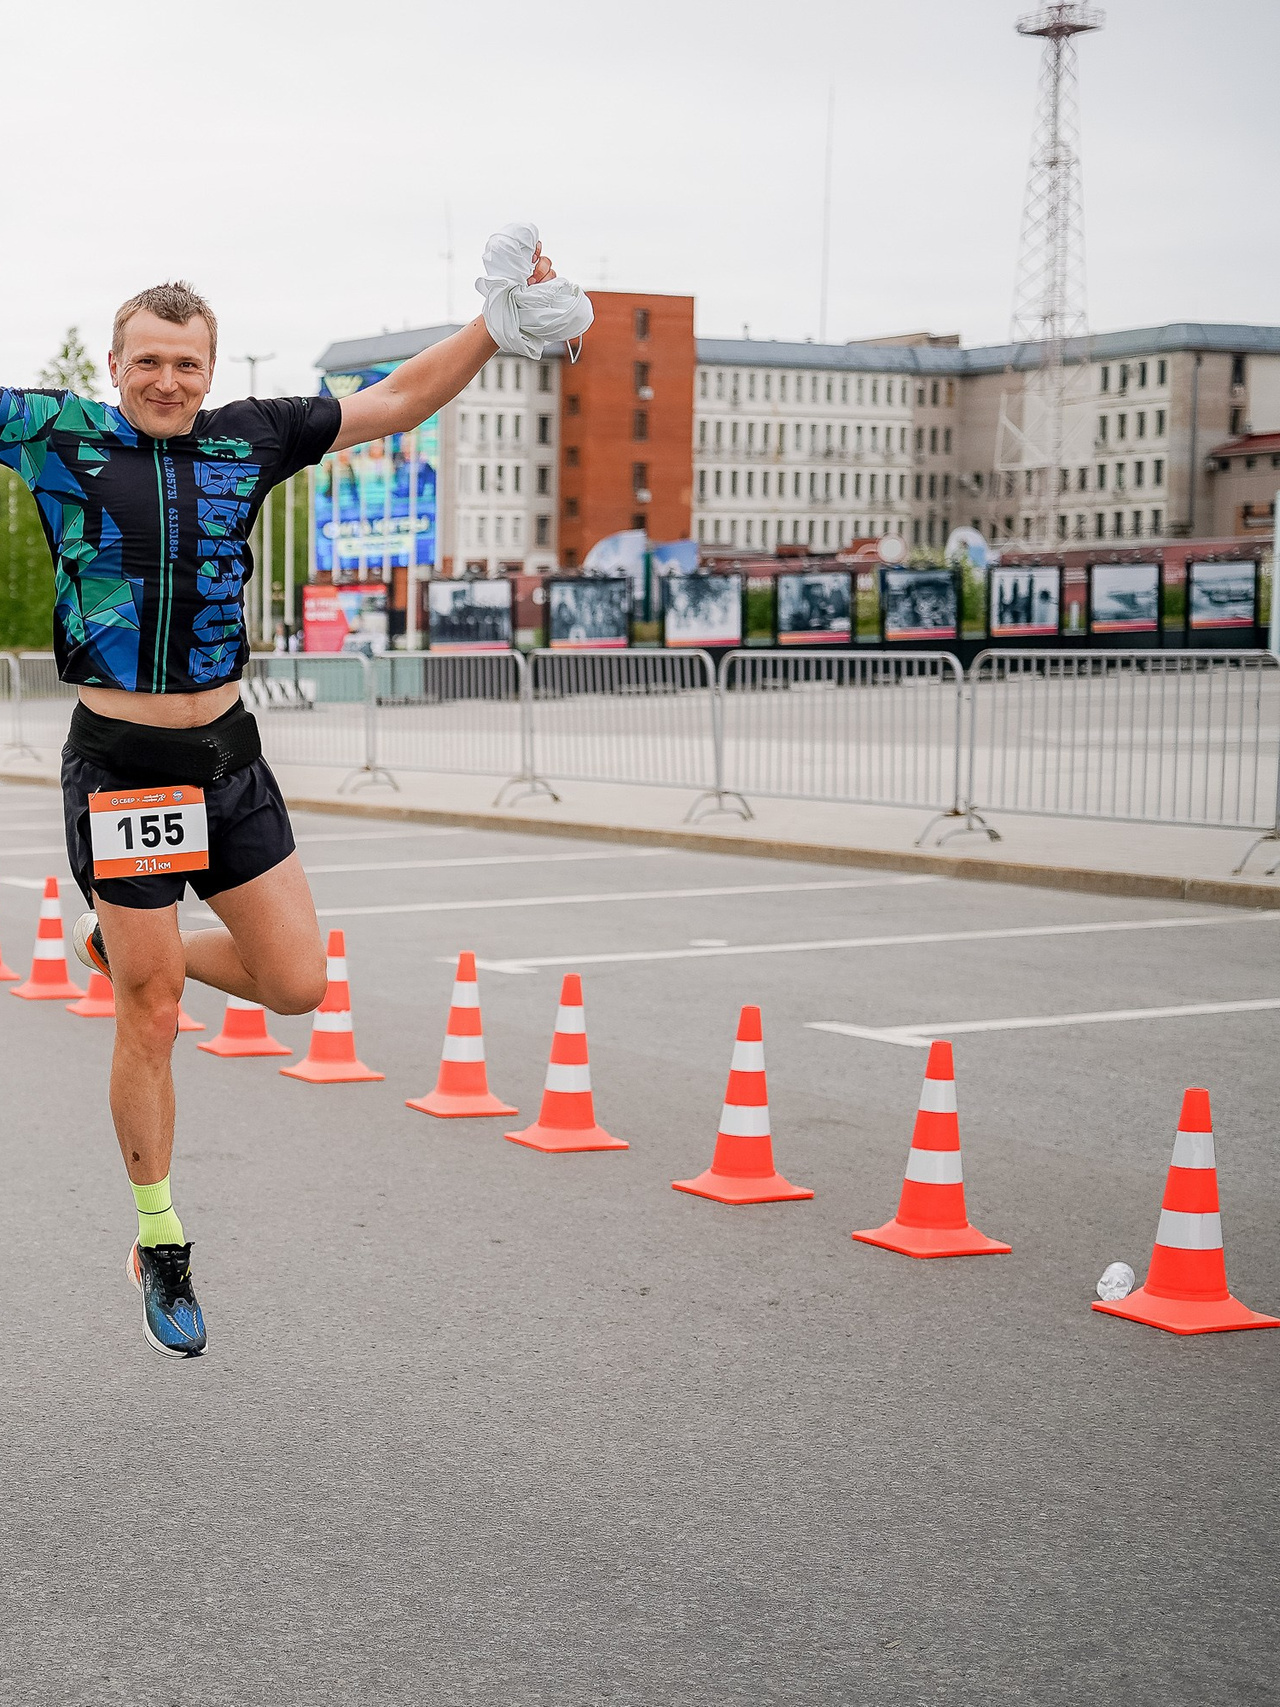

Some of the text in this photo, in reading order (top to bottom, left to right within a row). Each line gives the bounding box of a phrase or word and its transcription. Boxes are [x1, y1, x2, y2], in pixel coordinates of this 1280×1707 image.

[163, 456, 179, 560] 61.285731 63.131884
[117, 812, 185, 850] 155
